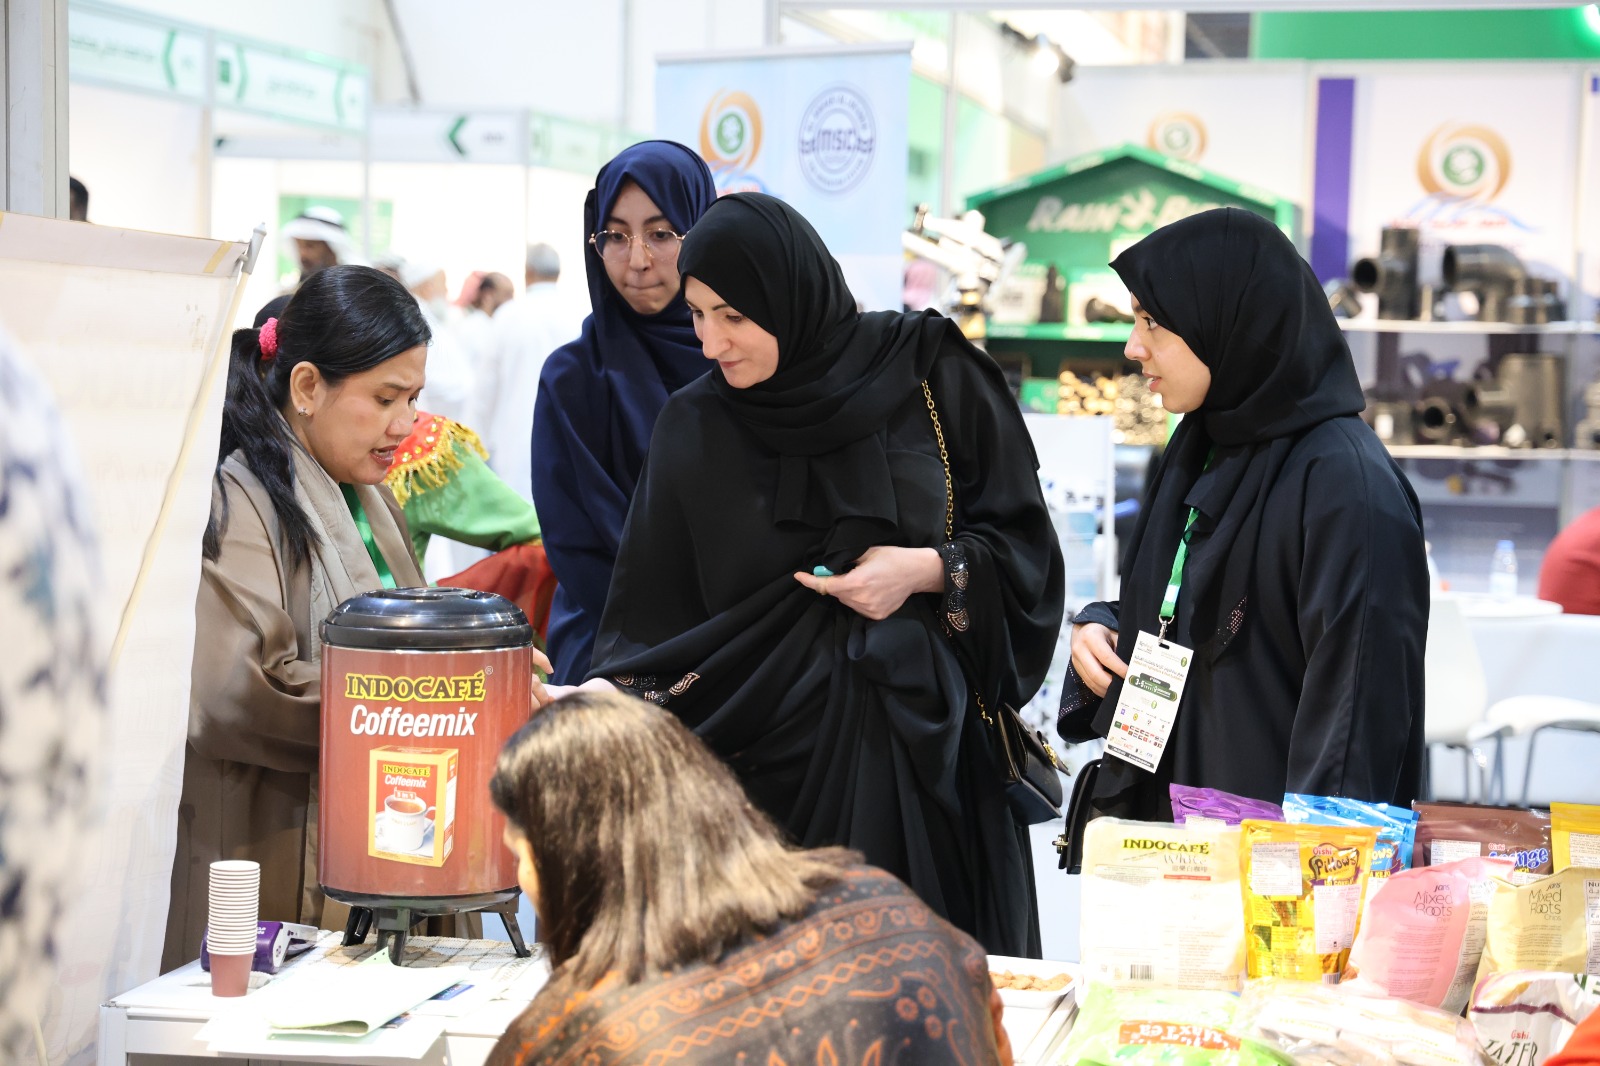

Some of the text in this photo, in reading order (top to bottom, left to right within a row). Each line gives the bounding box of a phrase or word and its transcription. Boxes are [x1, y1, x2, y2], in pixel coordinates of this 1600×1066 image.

[346, 670, 485, 701] INDOCAFÉ
[351, 705, 478, 737] Coffeemix
[385, 775, 427, 788] Coffeemix
[1123, 839, 1209, 854] INDOCAFÉ
[1312, 847, 1332, 856] Oishi
[1414, 891, 1452, 904] Mixed
[1529, 889, 1561, 903] Mixed
[1416, 904, 1452, 917] Roots
[1530, 902, 1561, 914] Roots
[1544, 913, 1561, 921] Chips
